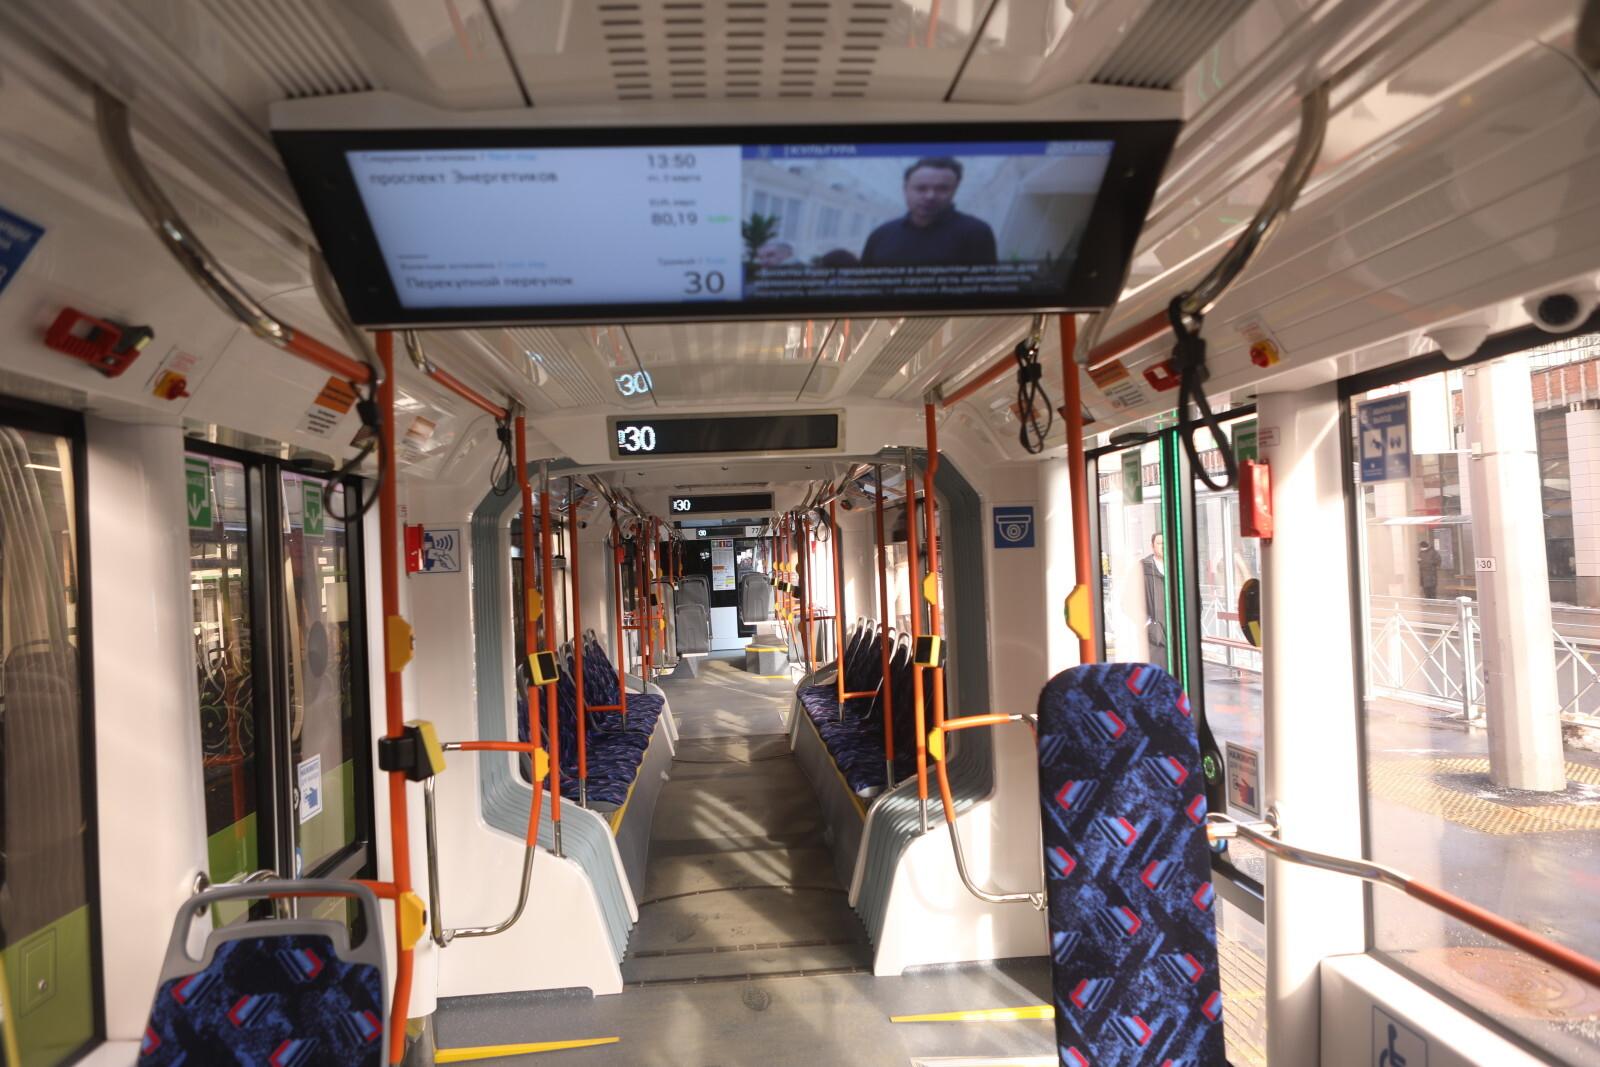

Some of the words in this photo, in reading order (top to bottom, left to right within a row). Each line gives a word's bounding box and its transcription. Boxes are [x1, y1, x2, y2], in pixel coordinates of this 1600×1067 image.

[647, 152, 697, 169] 13:50
[369, 172, 445, 186] проспект
[452, 169, 558, 186] Энергетиков
[650, 211, 699, 227] 80,19
[683, 270, 725, 295] 30
[623, 426, 656, 452] 30
[676, 499, 691, 511] 30
